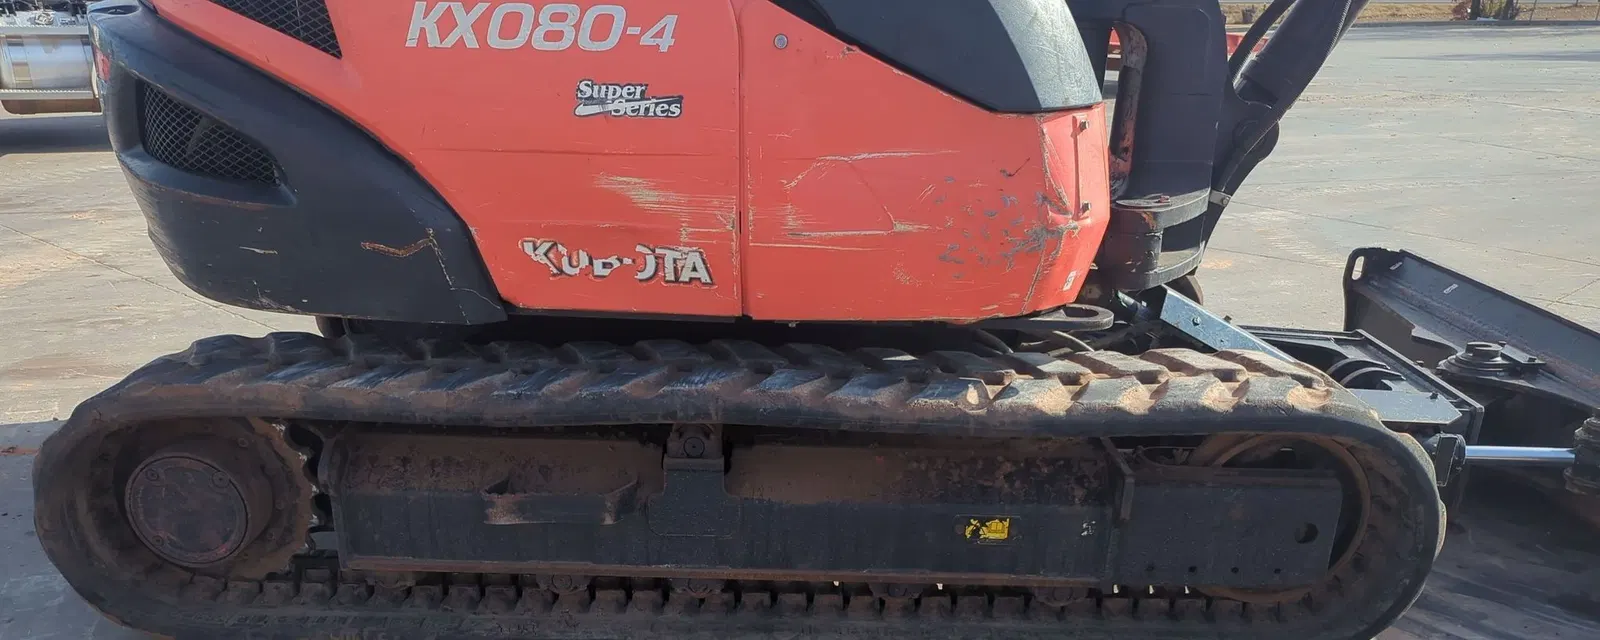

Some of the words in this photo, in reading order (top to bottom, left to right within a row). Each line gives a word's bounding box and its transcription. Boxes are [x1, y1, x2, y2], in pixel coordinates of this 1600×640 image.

[405, 1, 678, 52] KX080-4
[577, 80, 646, 102] Super
[611, 99, 682, 117] Series
